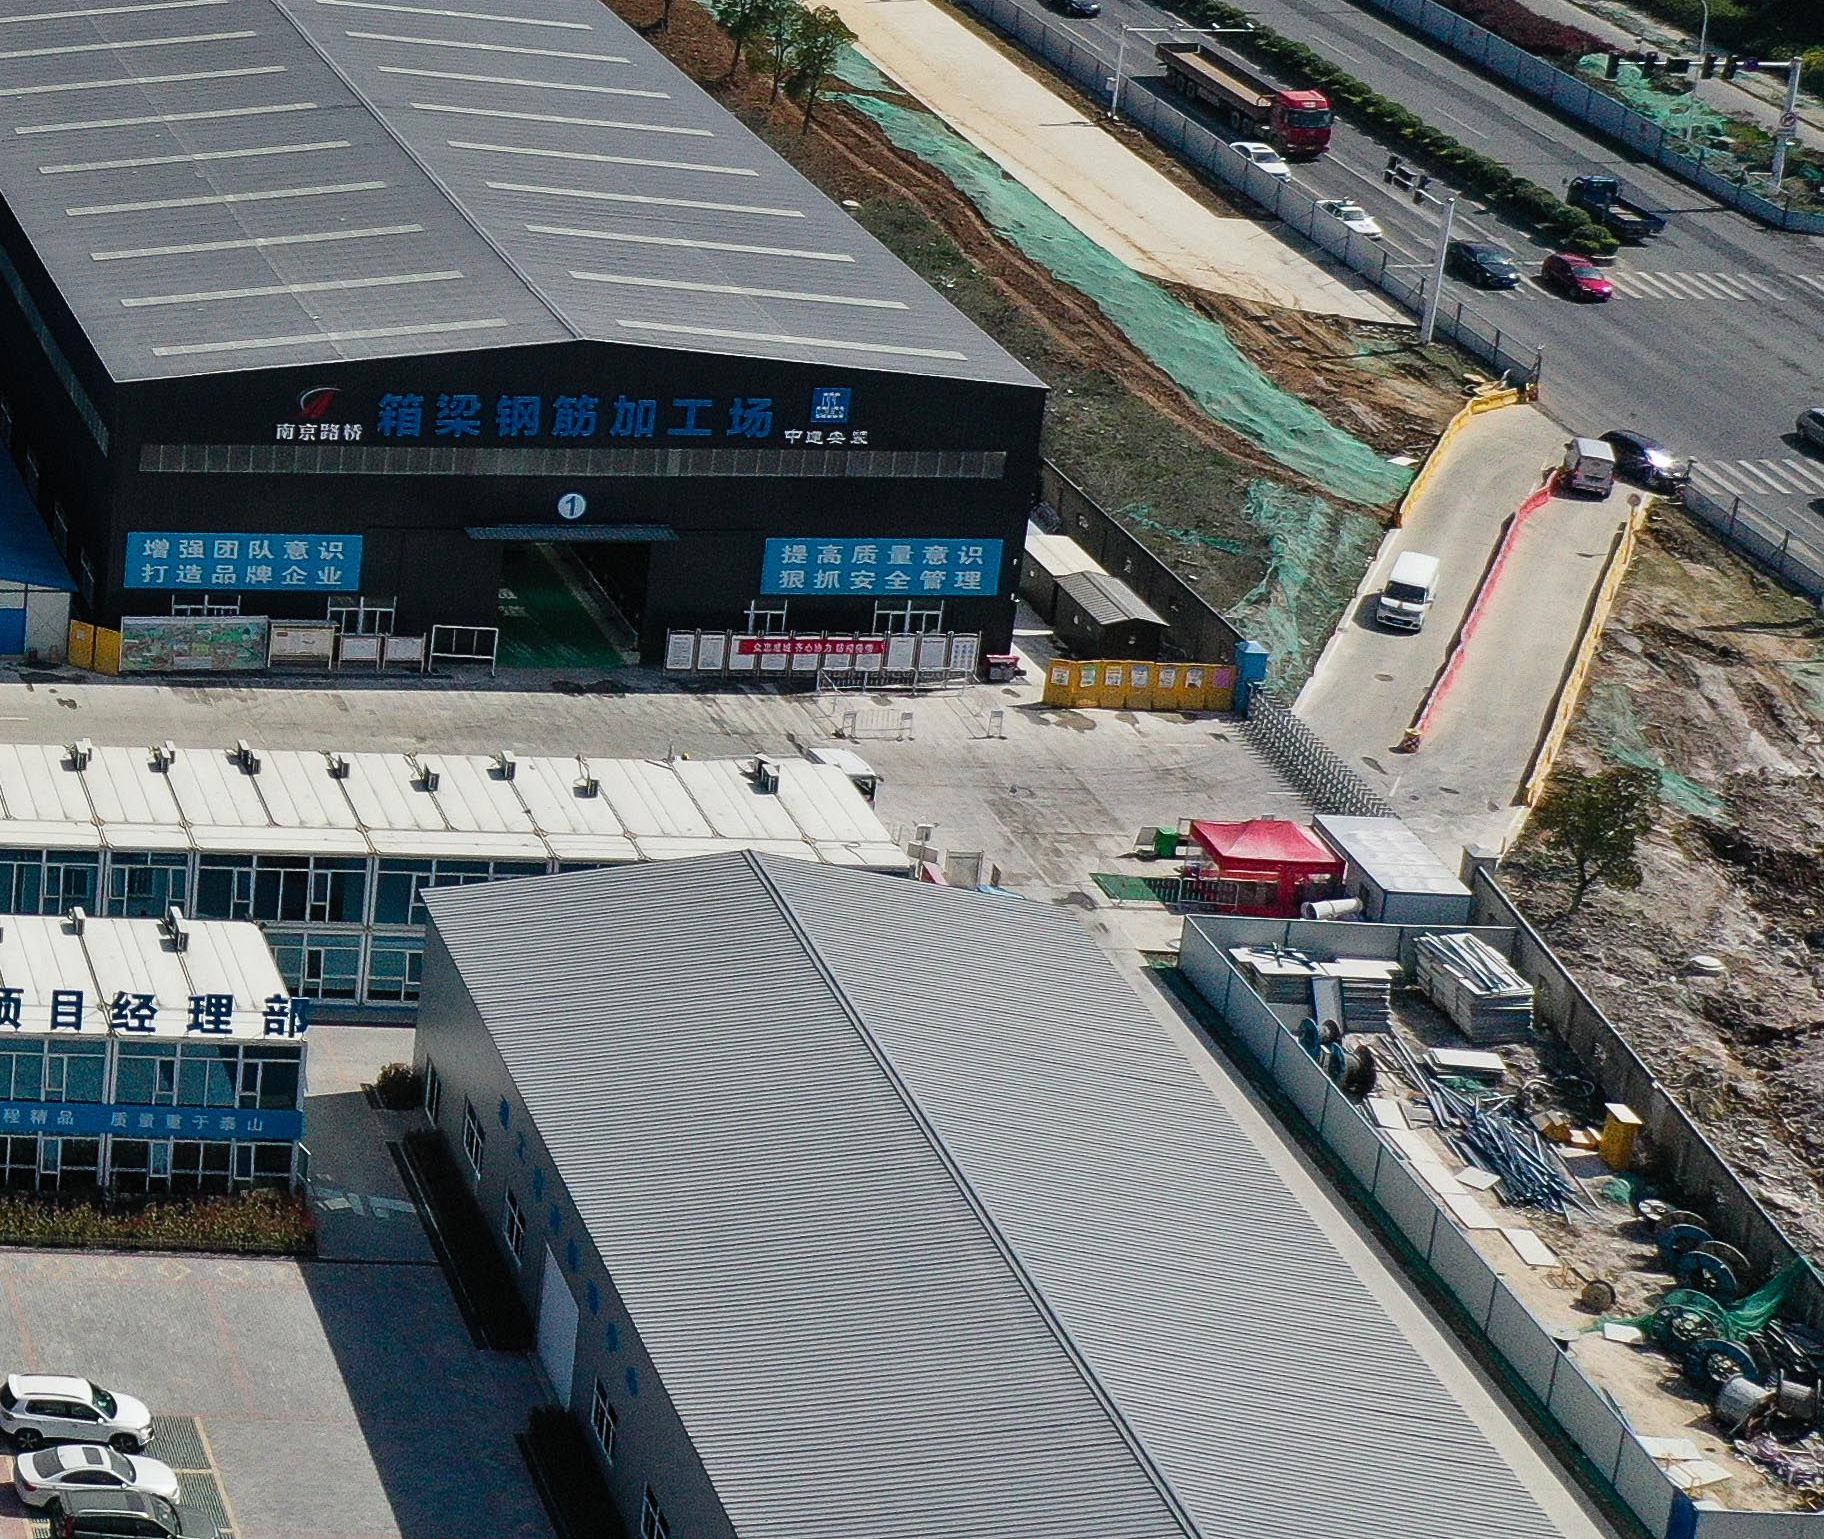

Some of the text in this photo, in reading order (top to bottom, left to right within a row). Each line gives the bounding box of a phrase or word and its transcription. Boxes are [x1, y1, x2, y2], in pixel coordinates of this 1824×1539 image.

[378, 392, 773, 440] 箱梁钢筋加工场
[275, 420, 363, 442] 南京路桥
[784, 429, 868, 445] 中建安装
[566, 494, 577, 518] 1
[142, 537, 345, 563] 增强团队意识
[780, 543, 986, 568] 提高质量意识
[141, 563, 344, 588] 打造品牌企业
[779, 569, 985, 595] 狠抓安全管理
[110, 1113, 263, 1133] 质量重于泰山
